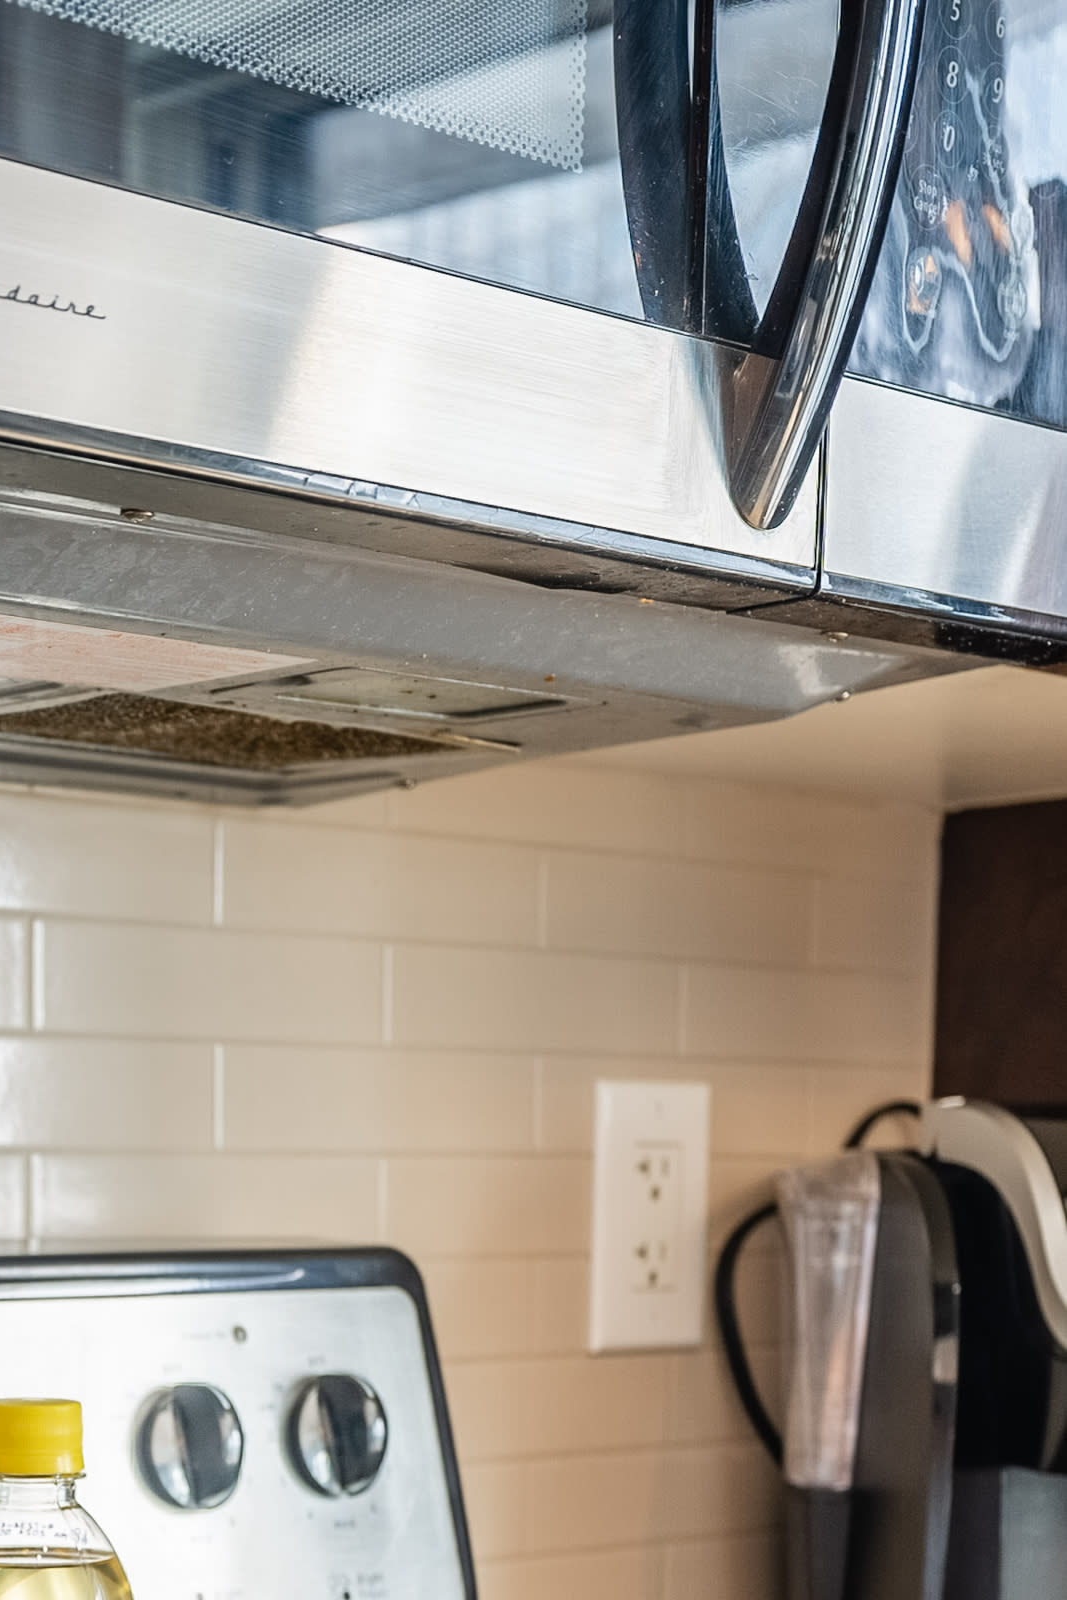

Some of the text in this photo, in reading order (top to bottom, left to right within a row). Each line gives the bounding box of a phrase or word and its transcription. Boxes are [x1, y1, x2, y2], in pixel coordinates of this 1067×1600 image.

[950, 0, 961, 21] 5
[996, 17, 1006, 38] 6
[946, 61, 959, 88] 8
[992, 77, 1003, 103] 9
[943, 125, 955, 151] 0
